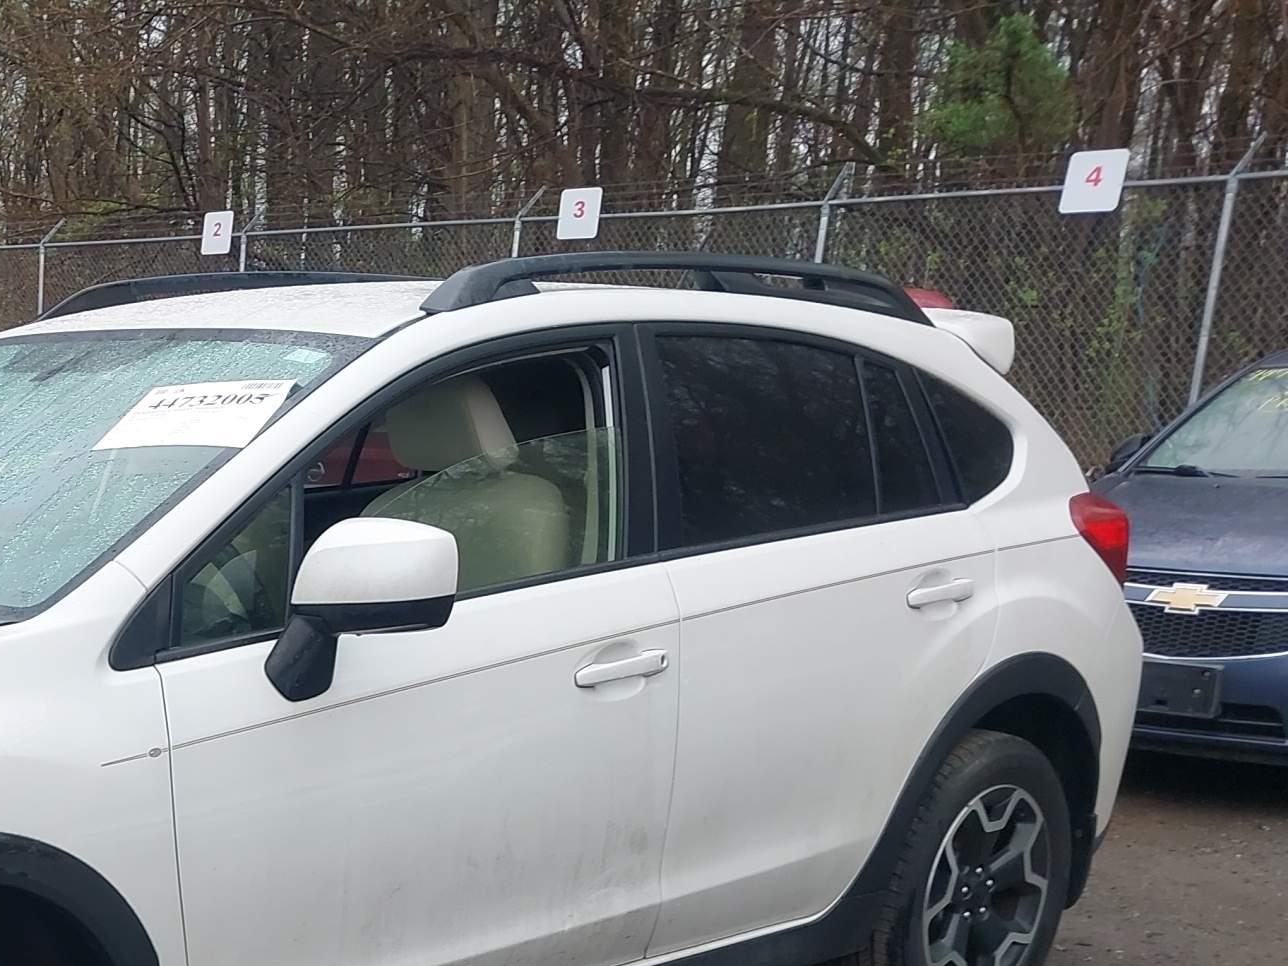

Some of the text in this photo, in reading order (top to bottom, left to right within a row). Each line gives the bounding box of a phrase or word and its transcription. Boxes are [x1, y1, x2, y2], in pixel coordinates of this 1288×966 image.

[1085, 166, 1103, 187] 4
[573, 201, 585, 218] 3
[213, 222, 222, 237] 2
[149, 393, 271, 410] 44732005
